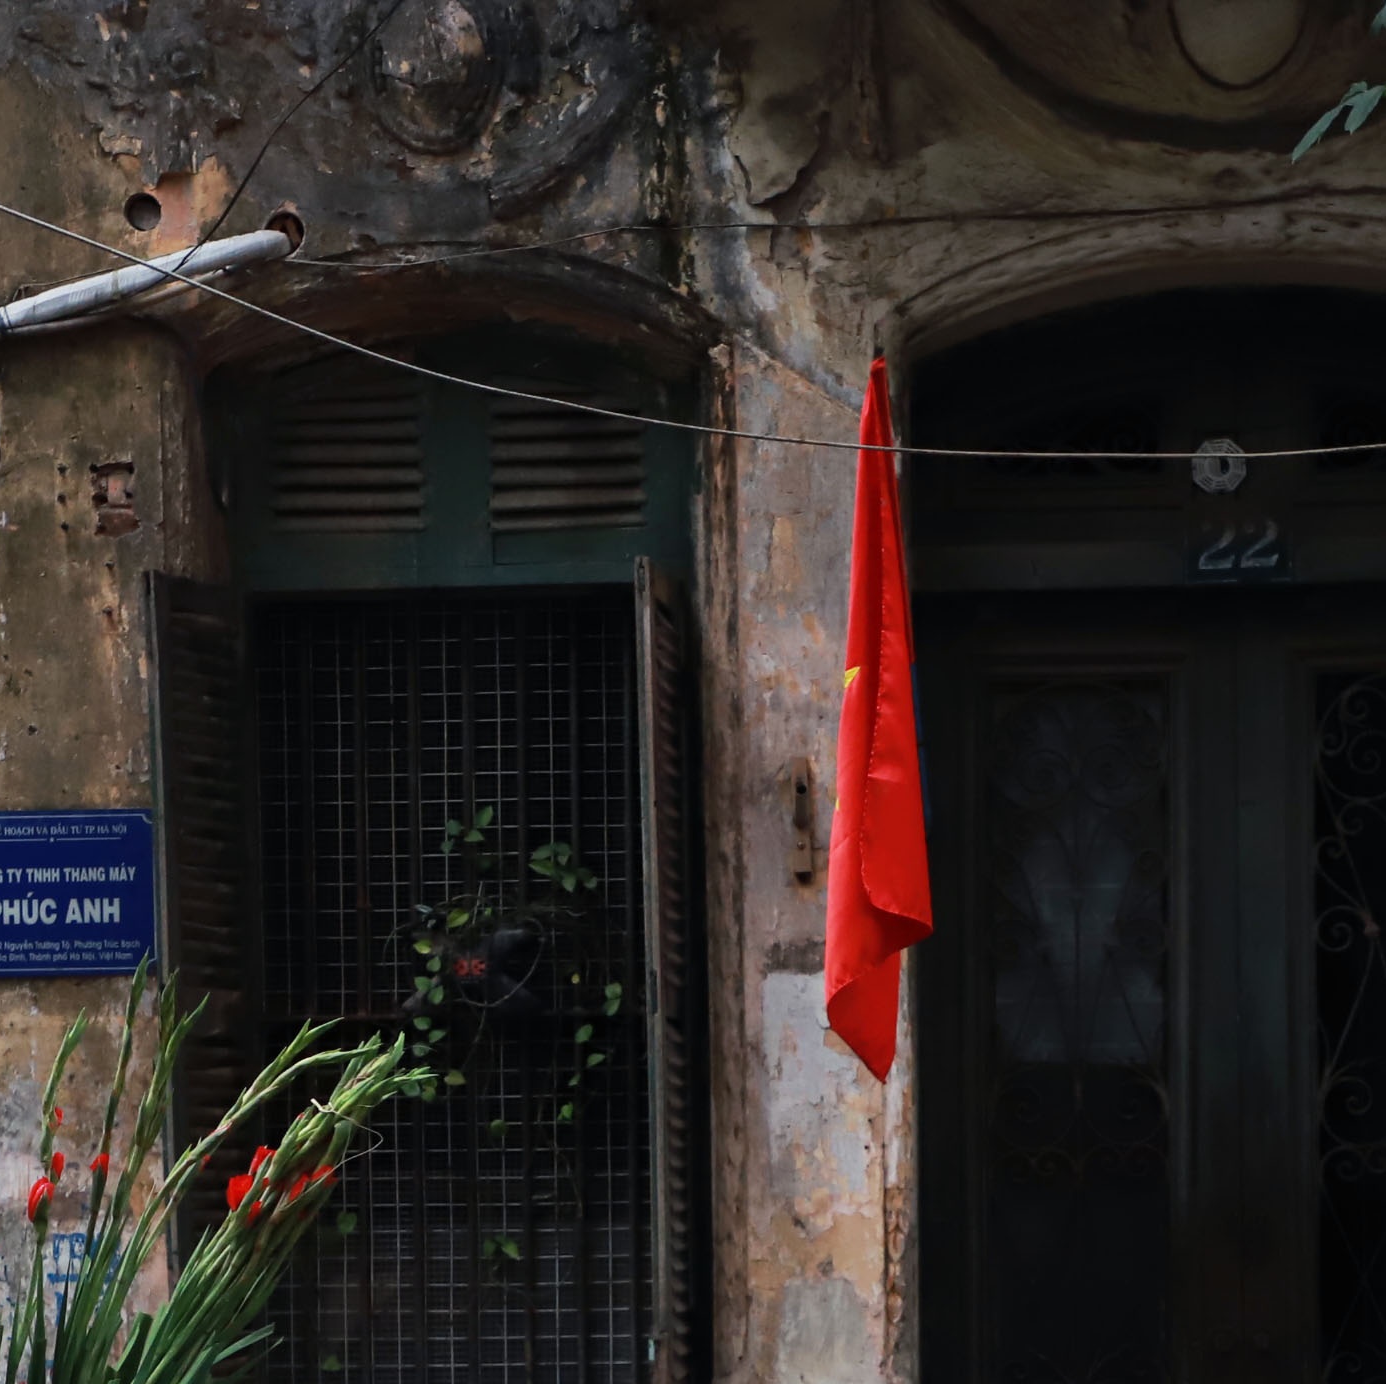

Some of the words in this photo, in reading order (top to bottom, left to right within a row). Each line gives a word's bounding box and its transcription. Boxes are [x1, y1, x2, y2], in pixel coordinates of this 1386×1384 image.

[1198, 520, 1279, 570] 22
[6, 867, 23, 884] TY
[25, 867, 60, 884] TNHH
[63, 866, 105, 883] THANG
[109, 861, 136, 883] MÁY
[64, 897, 120, 924] ANH
